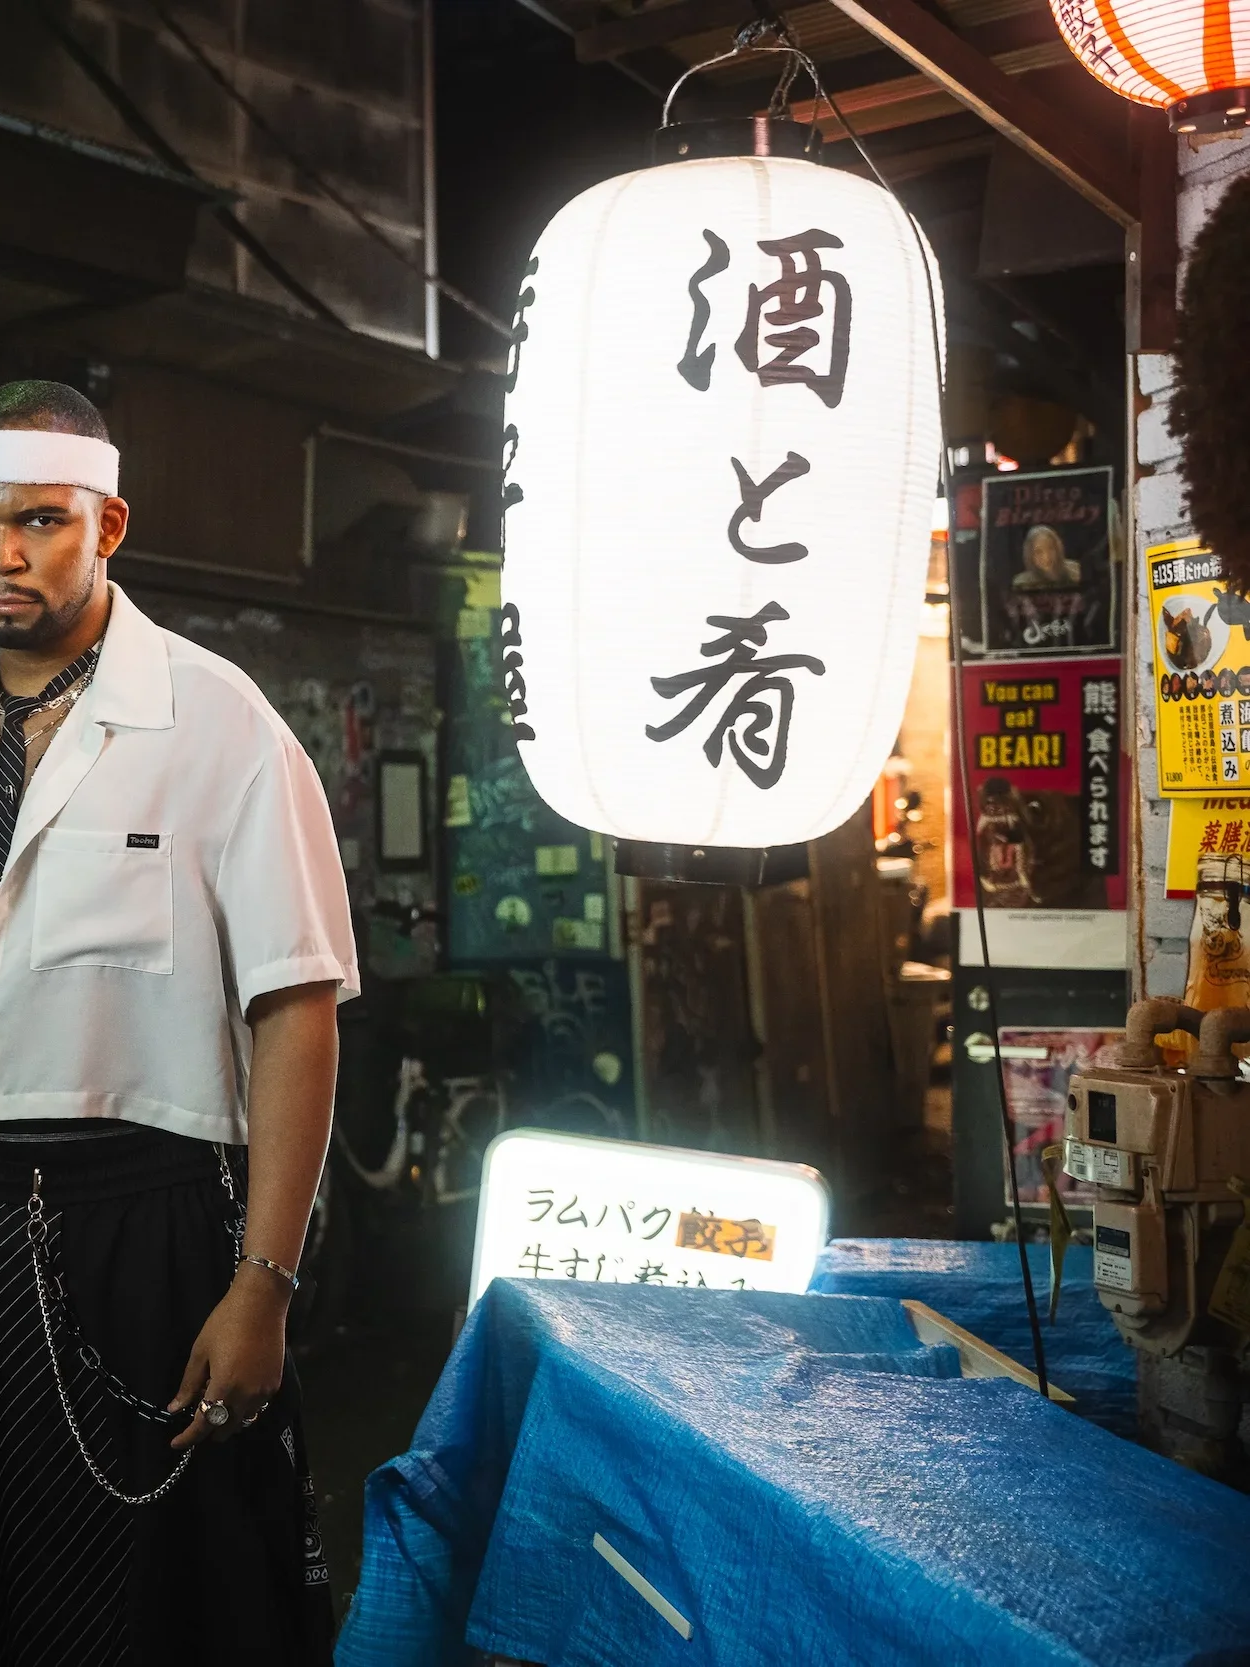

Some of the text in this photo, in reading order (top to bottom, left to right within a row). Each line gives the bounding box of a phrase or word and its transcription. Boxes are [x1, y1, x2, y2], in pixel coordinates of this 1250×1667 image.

[646, 228, 853, 789] 酒と肴
[985, 681, 1054, 702] You can
[1005, 707, 1034, 728] eat
[980, 735, 1060, 767] BEAR!
[1220, 704, 1237, 778] 煮込み
